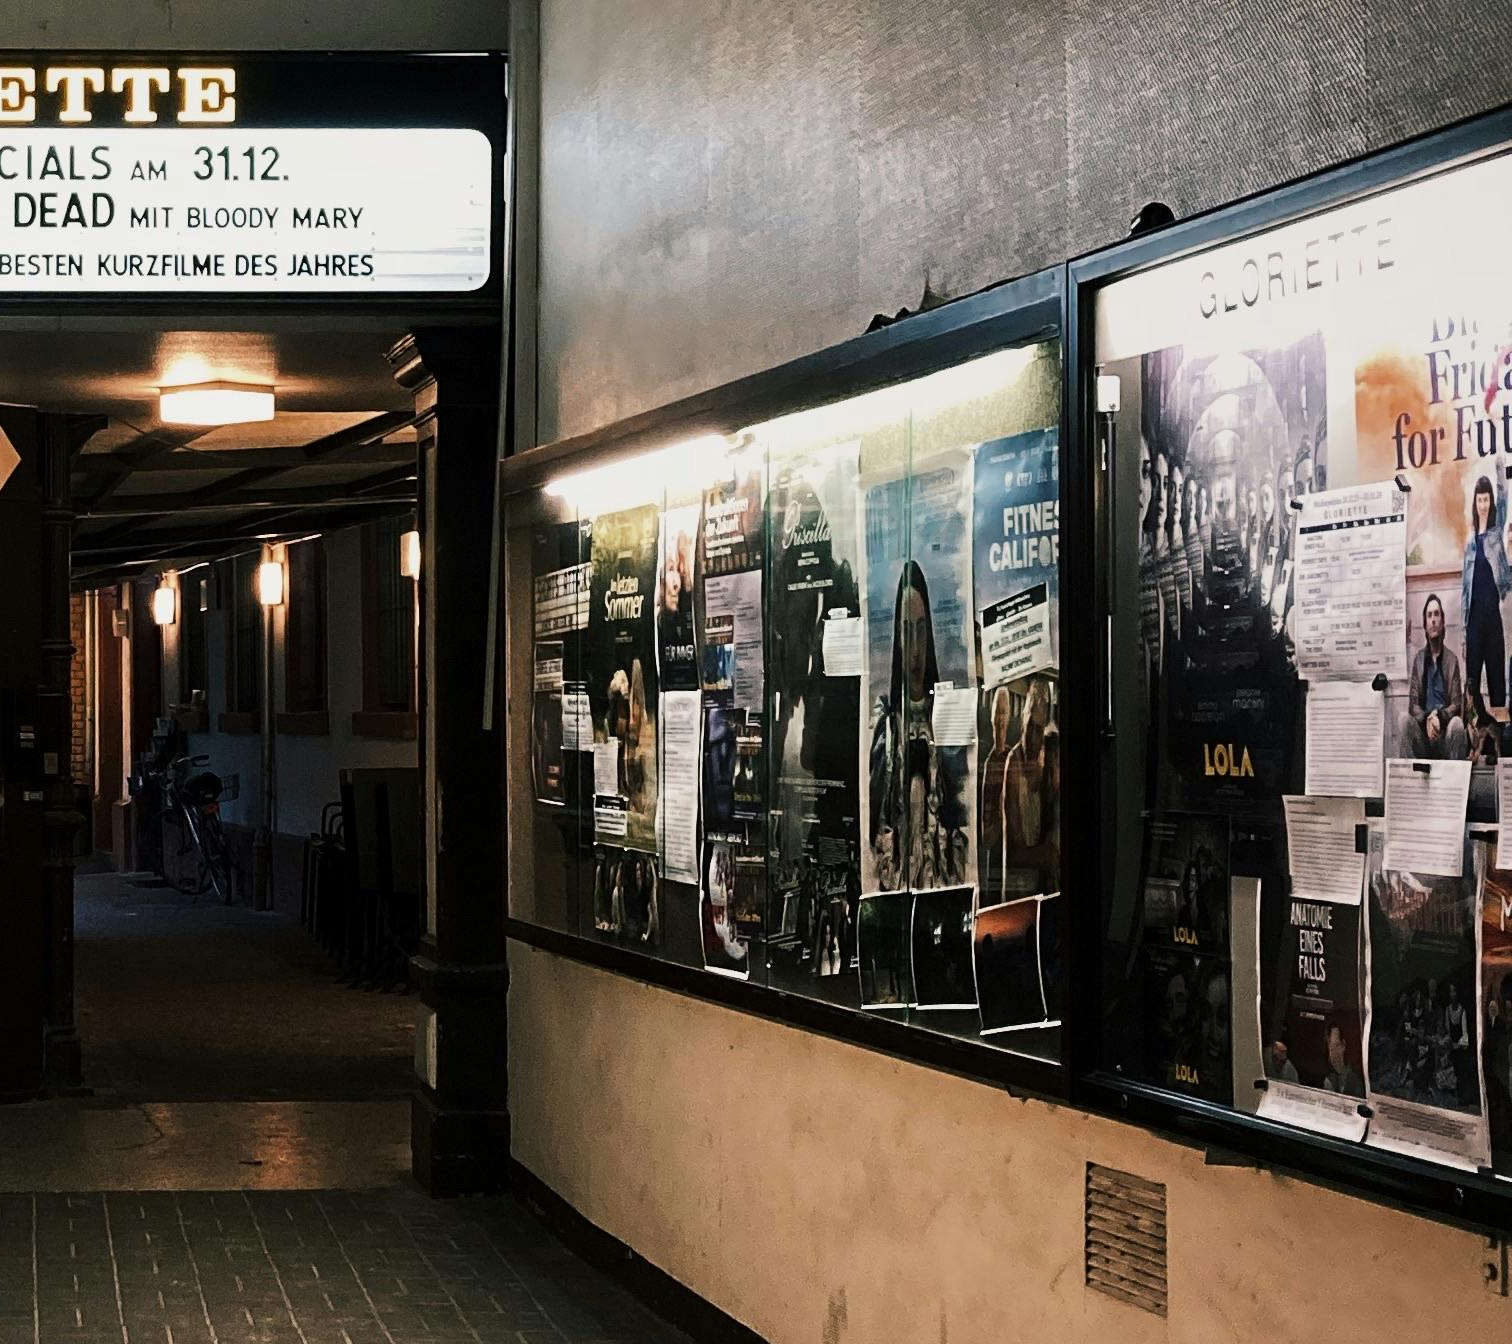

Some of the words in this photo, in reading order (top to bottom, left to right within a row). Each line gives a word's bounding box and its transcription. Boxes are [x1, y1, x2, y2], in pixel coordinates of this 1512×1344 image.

[130, 160, 167, 180] AM
[193, 145, 289, 181] 31.12.
[14, 192, 115, 228] DEAD
[130, 207, 174, 228] MIT
[188, 207, 279, 228] BLOODY
[292, 207, 364, 229] MARY
[0, 253, 83, 276] BESTEN
[97, 254, 225, 277] KURZFILME
[235, 254, 278, 276] DES
[287, 254, 374, 277] JAHRES
[1199, 217, 1395, 319] GLORIETTE
[1392, 412, 1445, 471] for
[604, 590, 645, 622] Sommer
[1204, 743, 1255, 777] LOLA
[1290, 901, 1333, 930] ANATOMIE
[1173, 926, 1199, 945] LOLA
[1299, 929, 1324, 955] EINES
[1298, 955, 1326, 982] FALLS
[1175, 1063, 1200, 1085] LOLA
